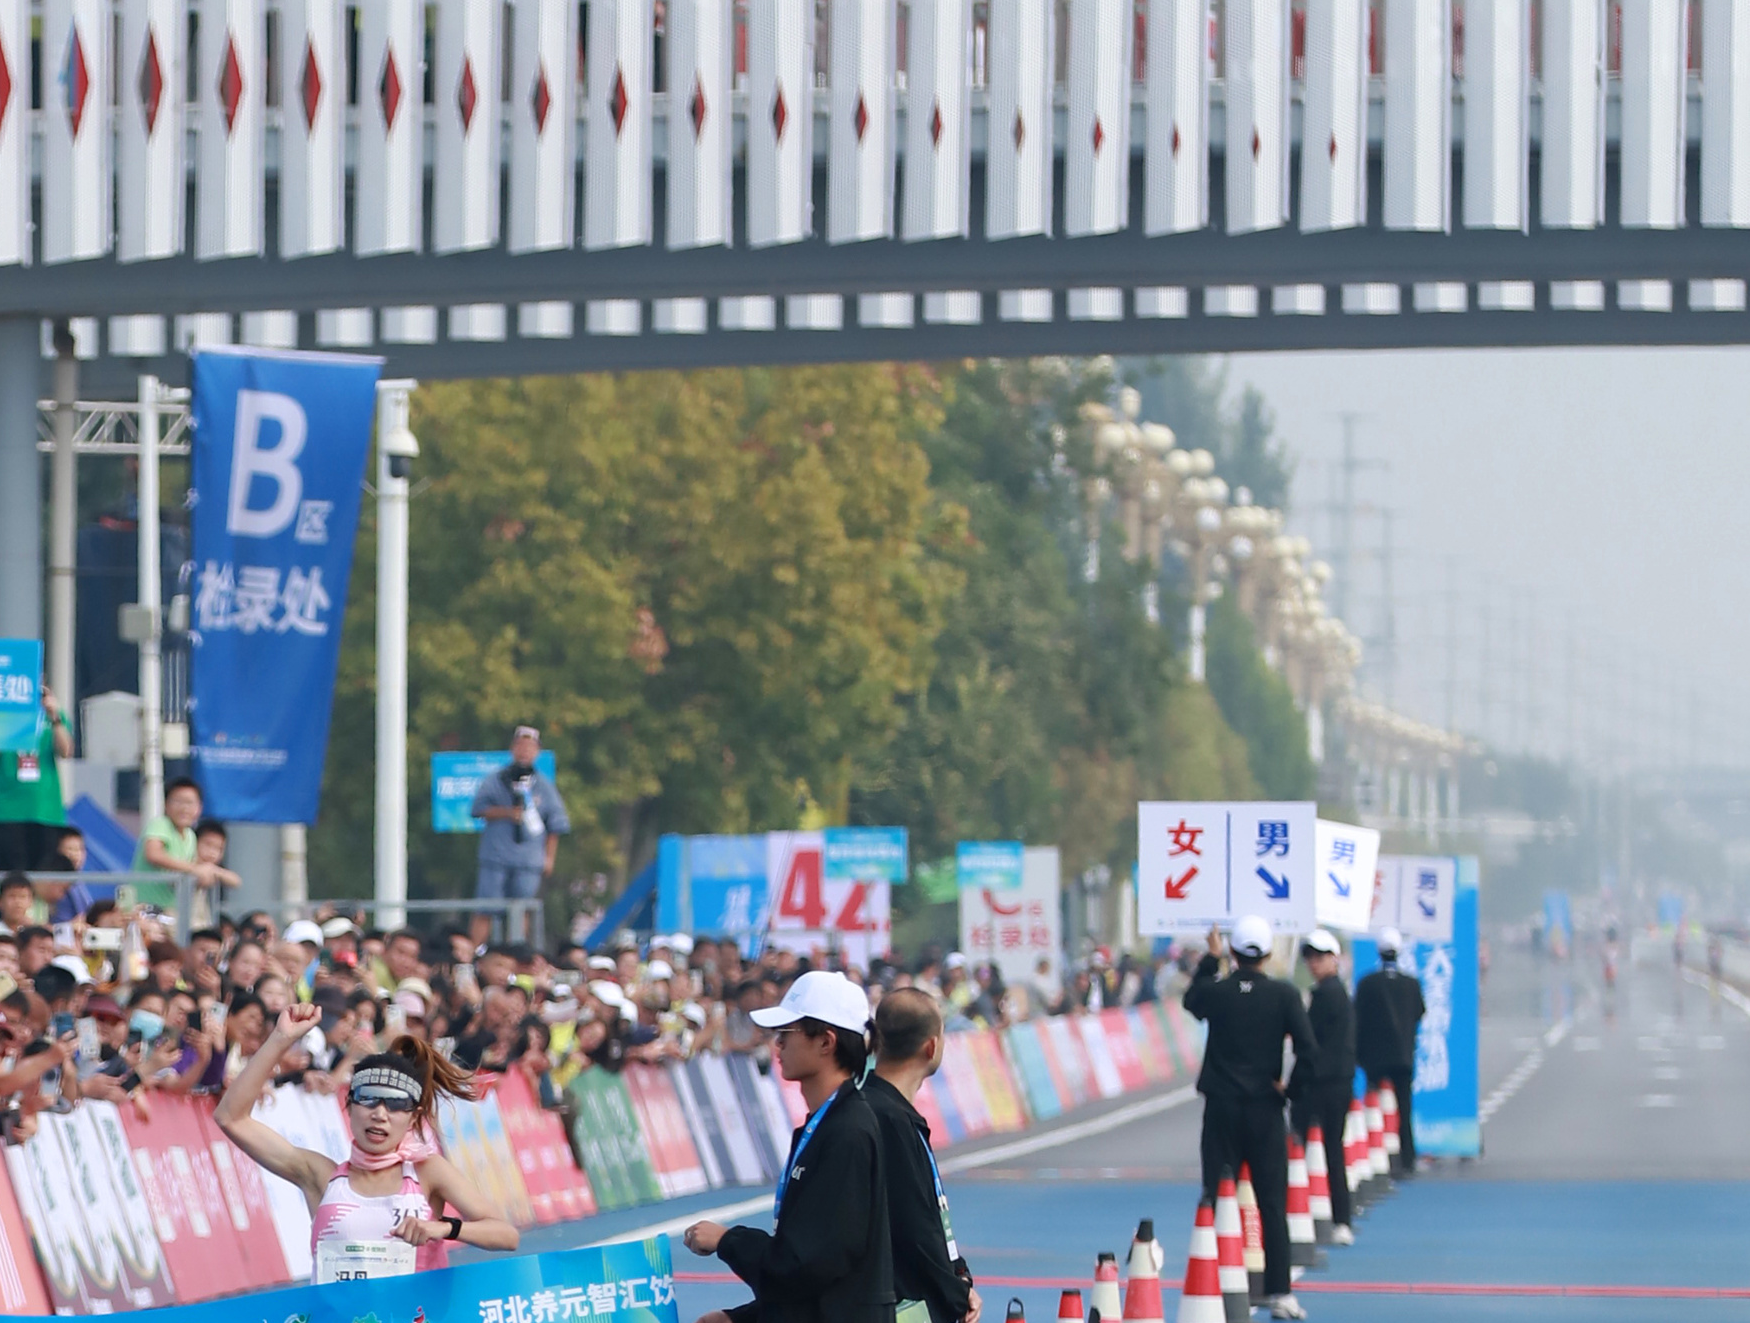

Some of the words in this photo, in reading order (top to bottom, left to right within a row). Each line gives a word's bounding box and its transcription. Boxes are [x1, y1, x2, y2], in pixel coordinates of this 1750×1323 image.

[195, 560, 331, 637] 检录处
[1167, 819, 1204, 856] 女
[1256, 820, 1291, 857] 男
[1328, 837, 1357, 866] 男
